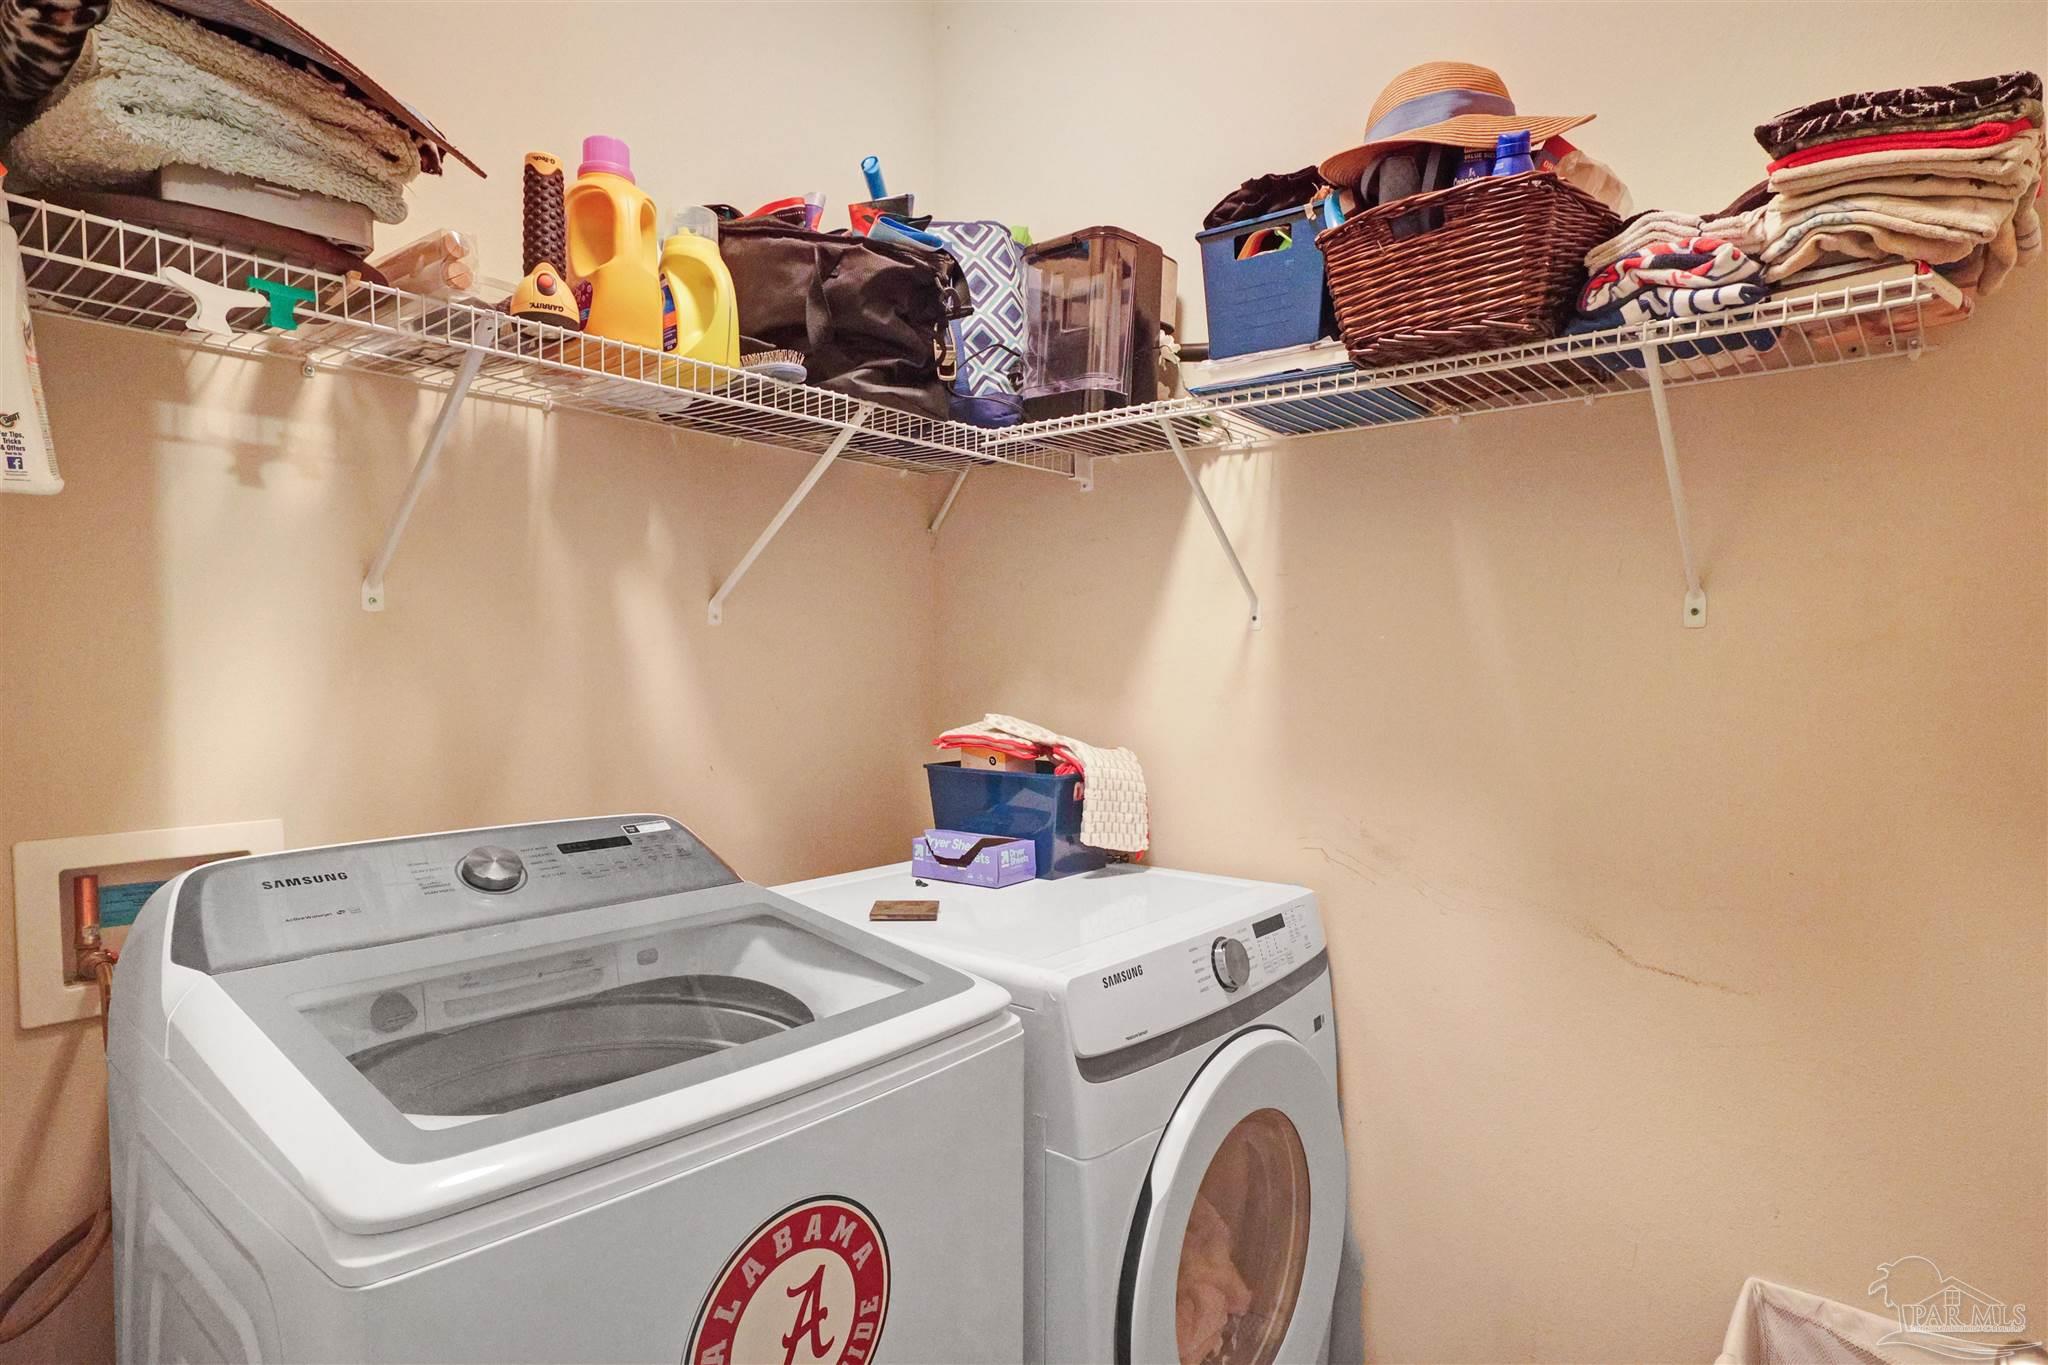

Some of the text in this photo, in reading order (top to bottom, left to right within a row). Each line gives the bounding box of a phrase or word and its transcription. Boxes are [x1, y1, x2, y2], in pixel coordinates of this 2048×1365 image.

[529, 302, 564, 312] GARRITY
[261, 872, 348, 890] SAMSUNG
[1102, 964, 1143, 988] SAMSUNG
[701, 1213, 874, 1365] ALABAMA
[842, 1296, 880, 1365] IDE
